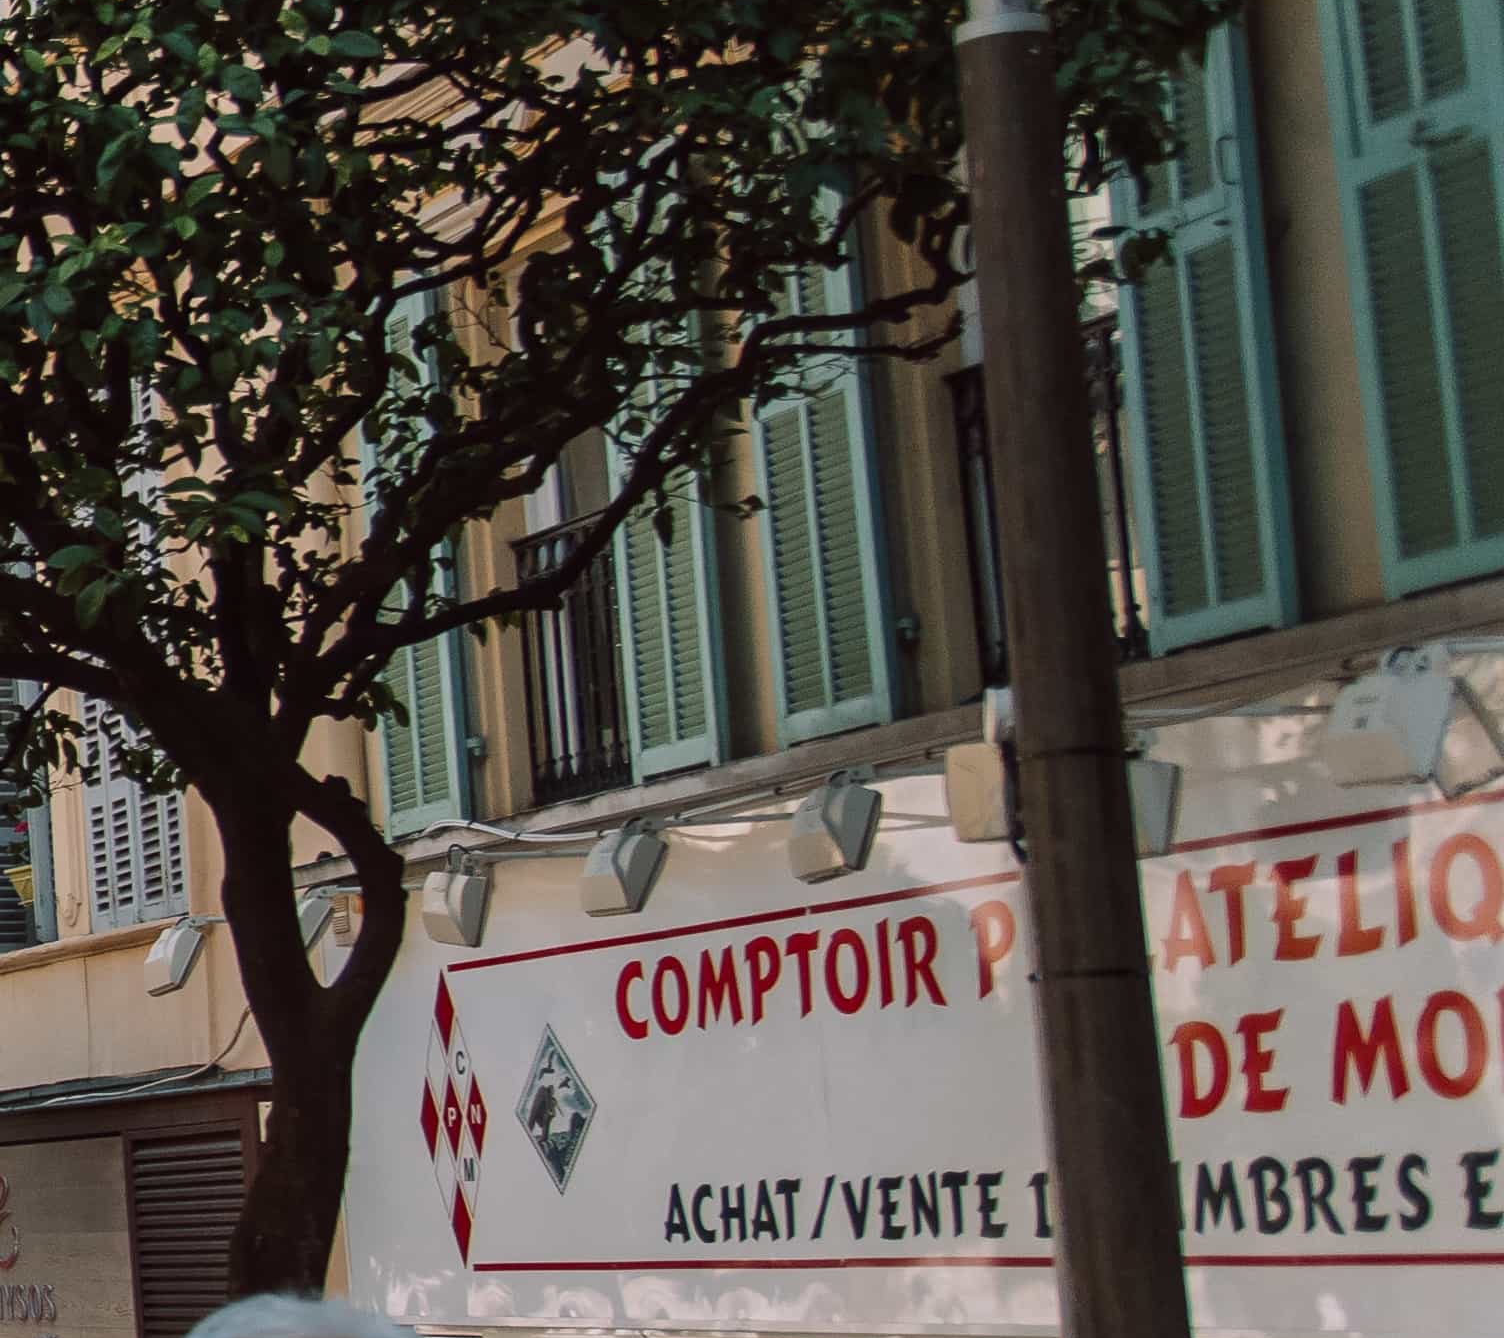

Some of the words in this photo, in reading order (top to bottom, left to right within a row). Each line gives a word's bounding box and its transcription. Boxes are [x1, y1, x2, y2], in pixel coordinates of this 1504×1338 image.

[615, 915, 948, 1041] COMPTOIR
[455, 1050, 466, 1076] C
[1168, 1007, 1291, 1120] DE
[1330, 986, 1504, 1107] MO
[447, 1107, 457, 1128] P
[470, 1103, 482, 1126] N
[463, 1157, 476, 1182] M
[1194, 1153, 1436, 1235] MBRES
